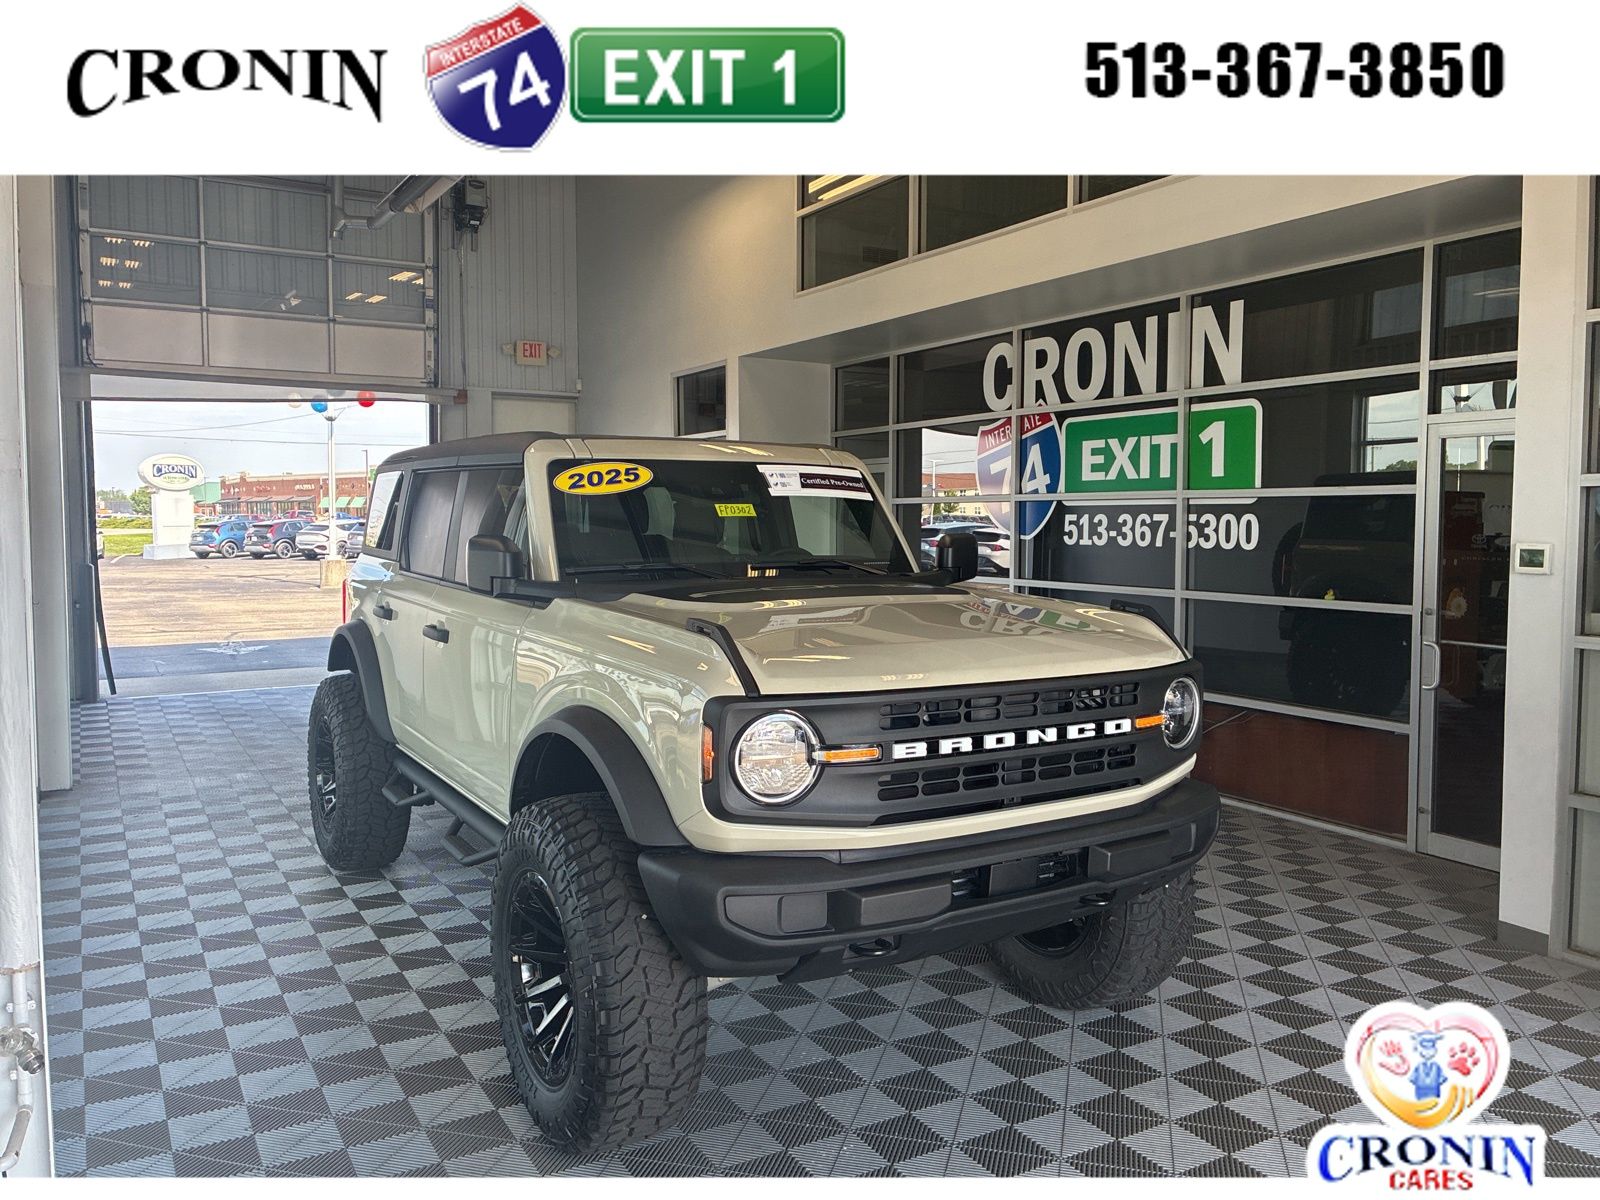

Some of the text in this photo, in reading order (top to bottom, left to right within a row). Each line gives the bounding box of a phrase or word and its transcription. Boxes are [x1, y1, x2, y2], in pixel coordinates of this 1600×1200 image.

[523, 342, 542, 358] EXIT
[983, 299, 1244, 411] CRONIN
[990, 443, 1051, 494] 74
[1081, 421, 1225, 481] EXIT 1
[153, 464, 197, 478] CRONIN
[568, 467, 640, 491] 2025
[801, 477, 829, 485] Certified
[830, 479, 864, 488] Pre-Owned
[1063, 513, 1259, 550] 513-367-5300
[892, 718, 1132, 760] BRONCO
